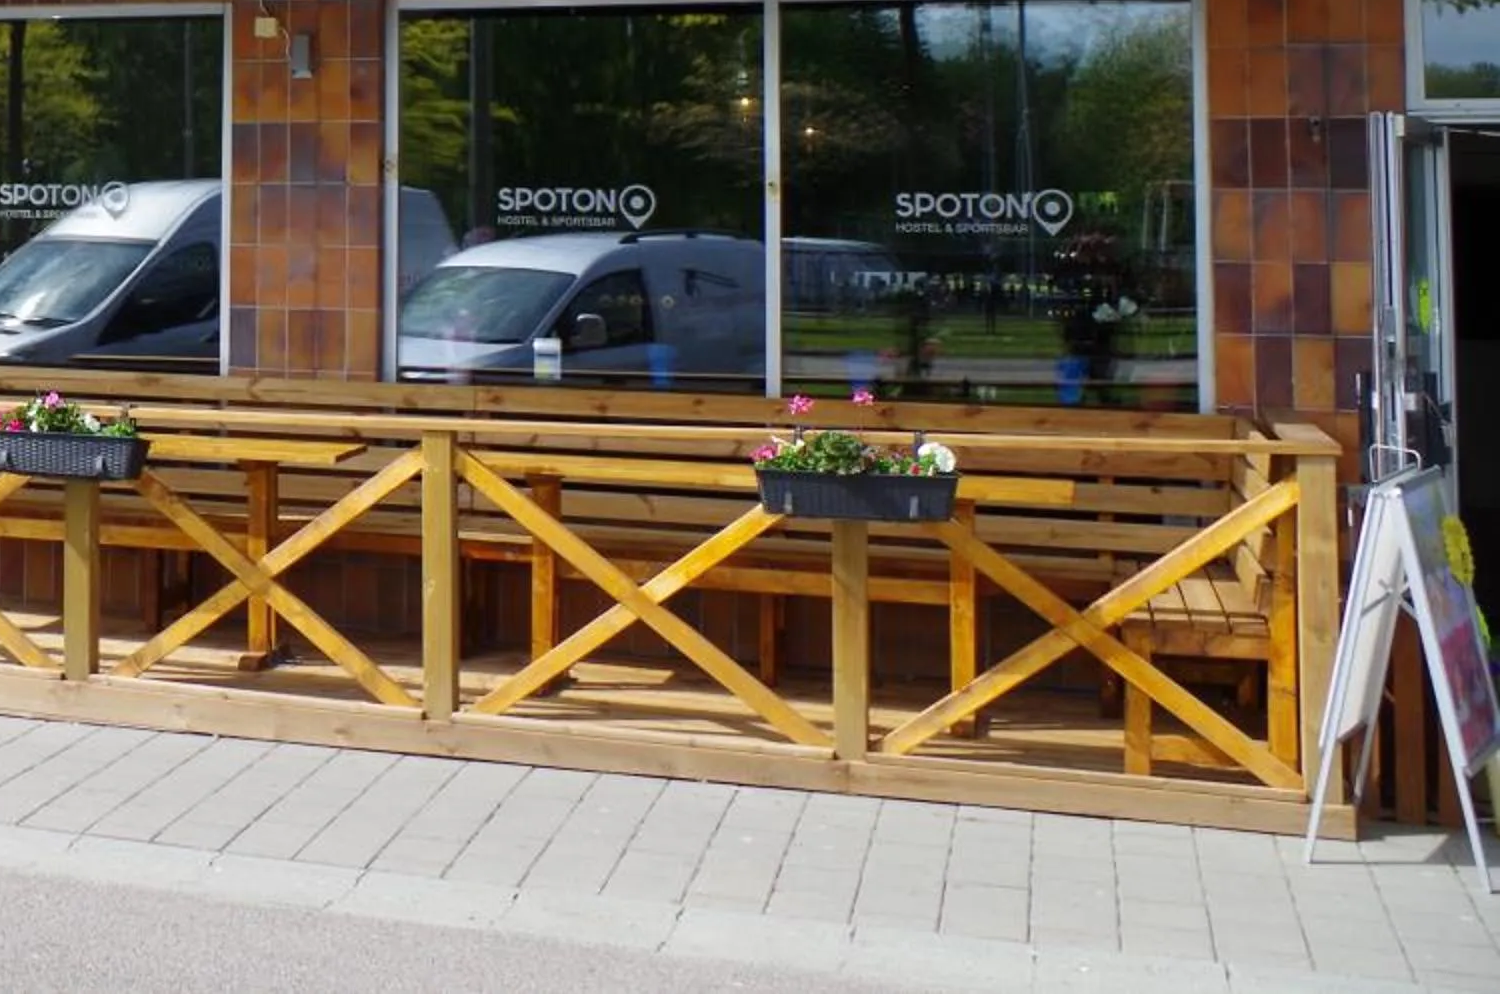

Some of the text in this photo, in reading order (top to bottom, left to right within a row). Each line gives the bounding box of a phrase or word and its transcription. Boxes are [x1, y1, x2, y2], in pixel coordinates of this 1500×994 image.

[0, 183, 99, 206] SPOTON
[498, 187, 617, 213] SPOTON
[896, 192, 1031, 219] SPOTON
[497, 215, 538, 226] HOSTEL
[551, 216, 617, 227] SPORTSBAR
[895, 222, 1029, 235] HOSTEL & SPORTSBAR
